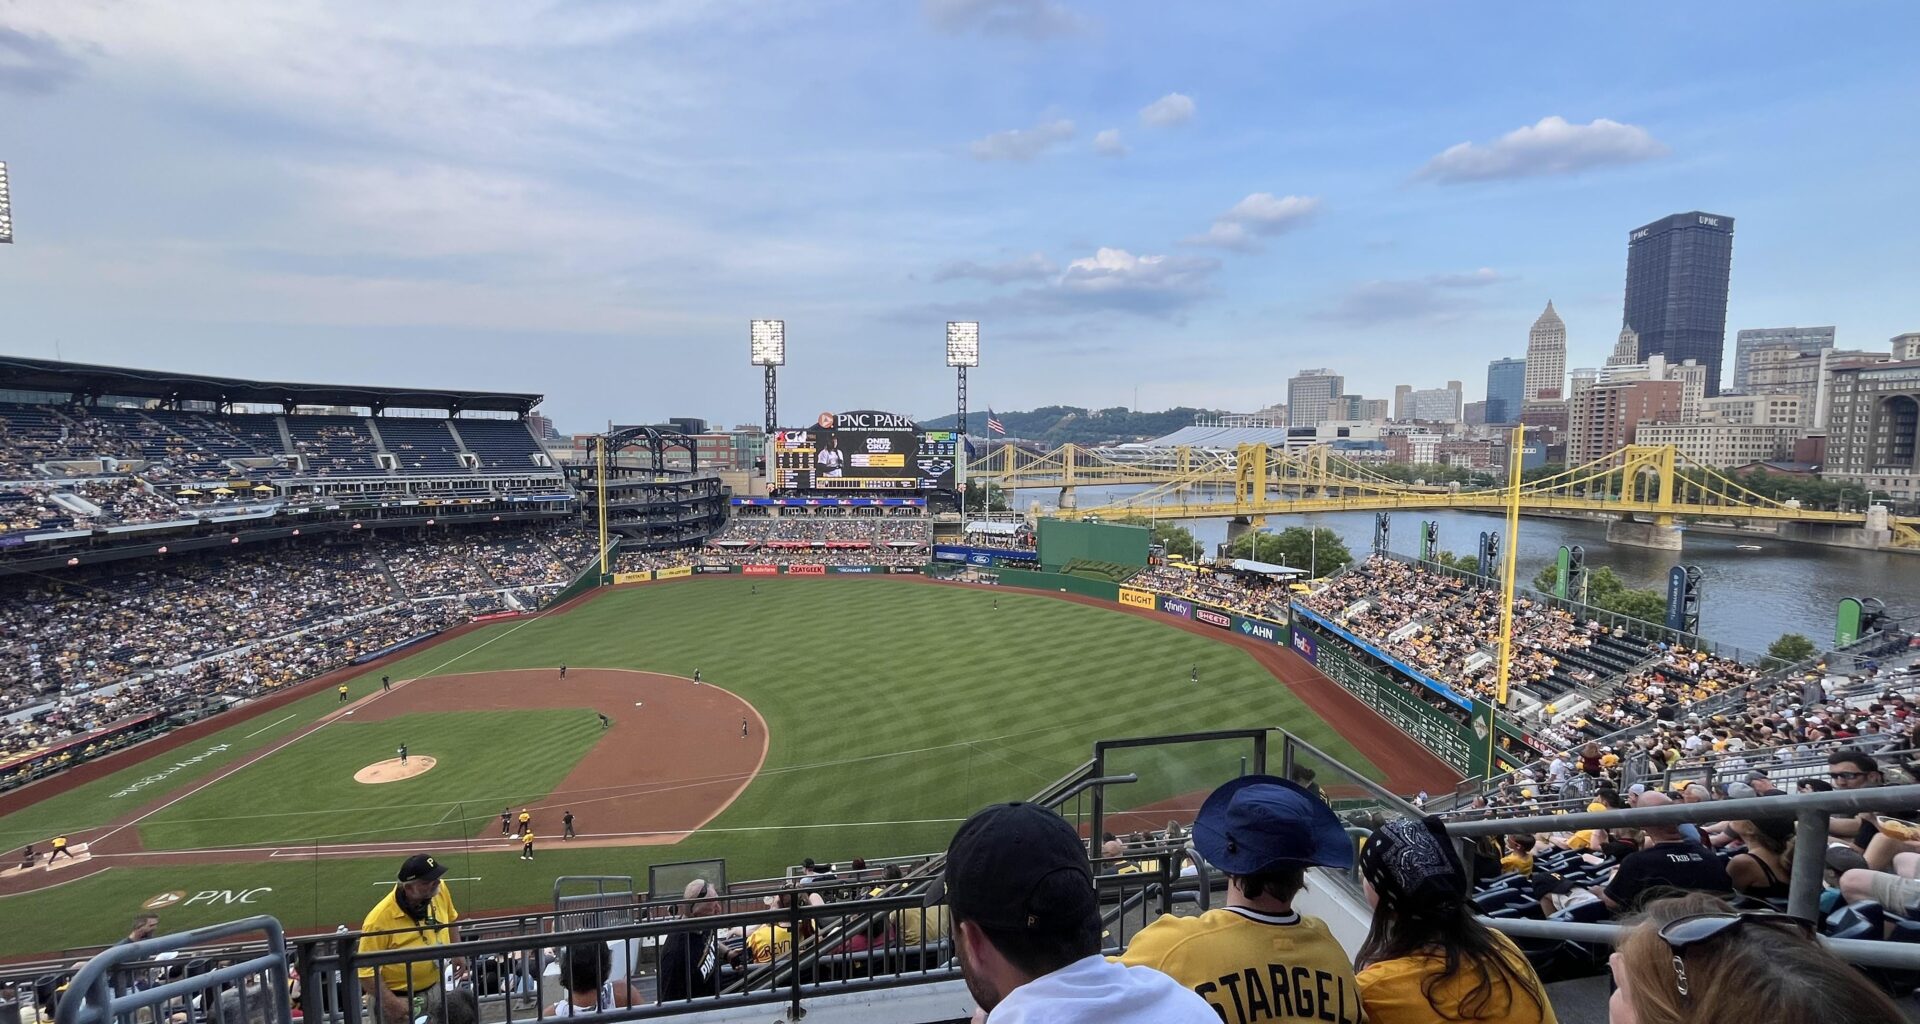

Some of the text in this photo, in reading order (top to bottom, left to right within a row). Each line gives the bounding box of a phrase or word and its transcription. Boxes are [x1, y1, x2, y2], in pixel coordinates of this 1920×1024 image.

[1699, 216, 1719, 226] UPMC
[837, 414, 913, 427] PNC PARK
[1130, 593, 1152, 605] LIGHT
[1164, 600, 1188, 616] xfinity
[1199, 611, 1228, 625] SHEETZ
[1252, 625, 1273, 640] AHN
[1294, 631, 1313, 656] FedEx
[426, 857, 434, 867] P
[183, 887, 272, 906] PNC
[1027, 915, 1035, 927] P
